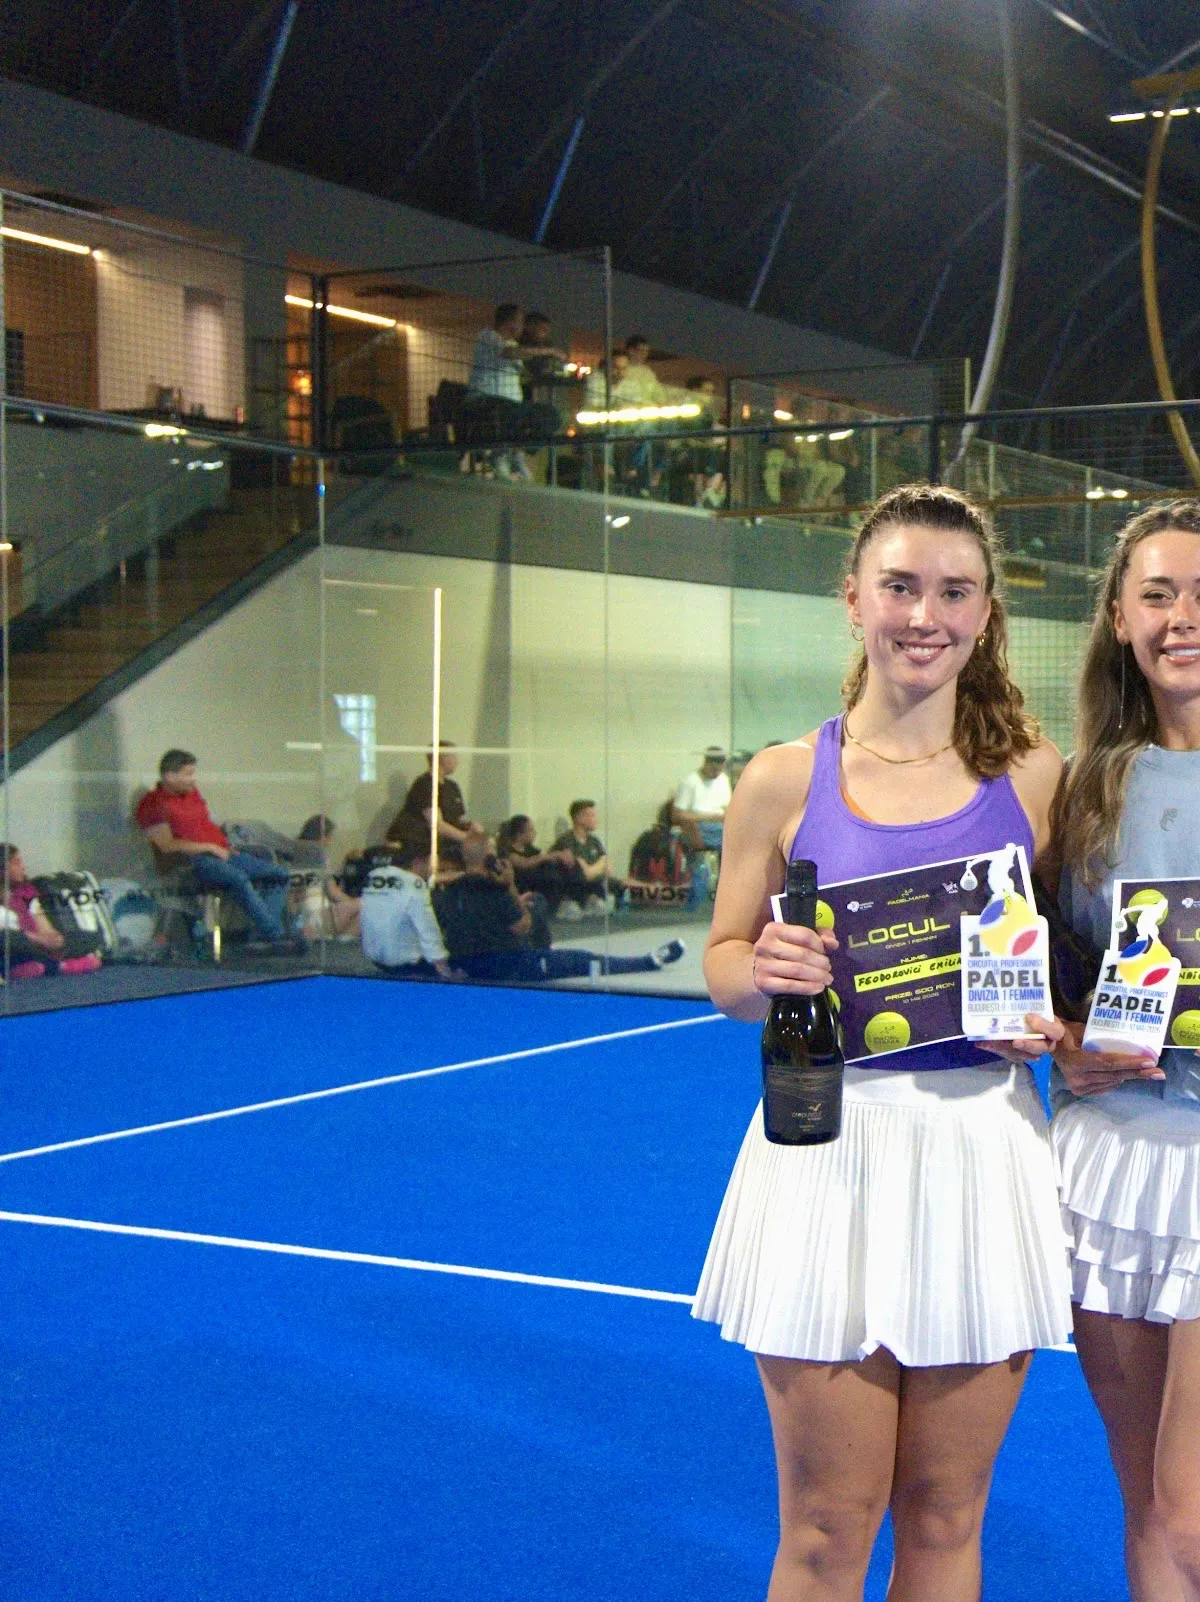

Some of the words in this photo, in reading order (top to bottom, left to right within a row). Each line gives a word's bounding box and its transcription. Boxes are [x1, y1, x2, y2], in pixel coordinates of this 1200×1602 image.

[887, 894, 930, 906] PADELMANIA
[848, 917, 950, 948] LOCUL
[968, 959, 999, 968] CIRCUITUL
[1000, 959, 1043, 968] PROFESIONIST
[968, 970, 1044, 988] PADEL
[968, 989, 999, 1001] DIVIZIA
[1002, 990, 1006, 1001] 1
[1009, 989, 1044, 1000] FEMININ
[1100, 983, 1128, 993] CIRCUITUL
[1096, 992, 1165, 1014] PADEL
[1094, 1008, 1122, 1020] DIVIZIA
[1130, 1012, 1163, 1025] FEMININ
